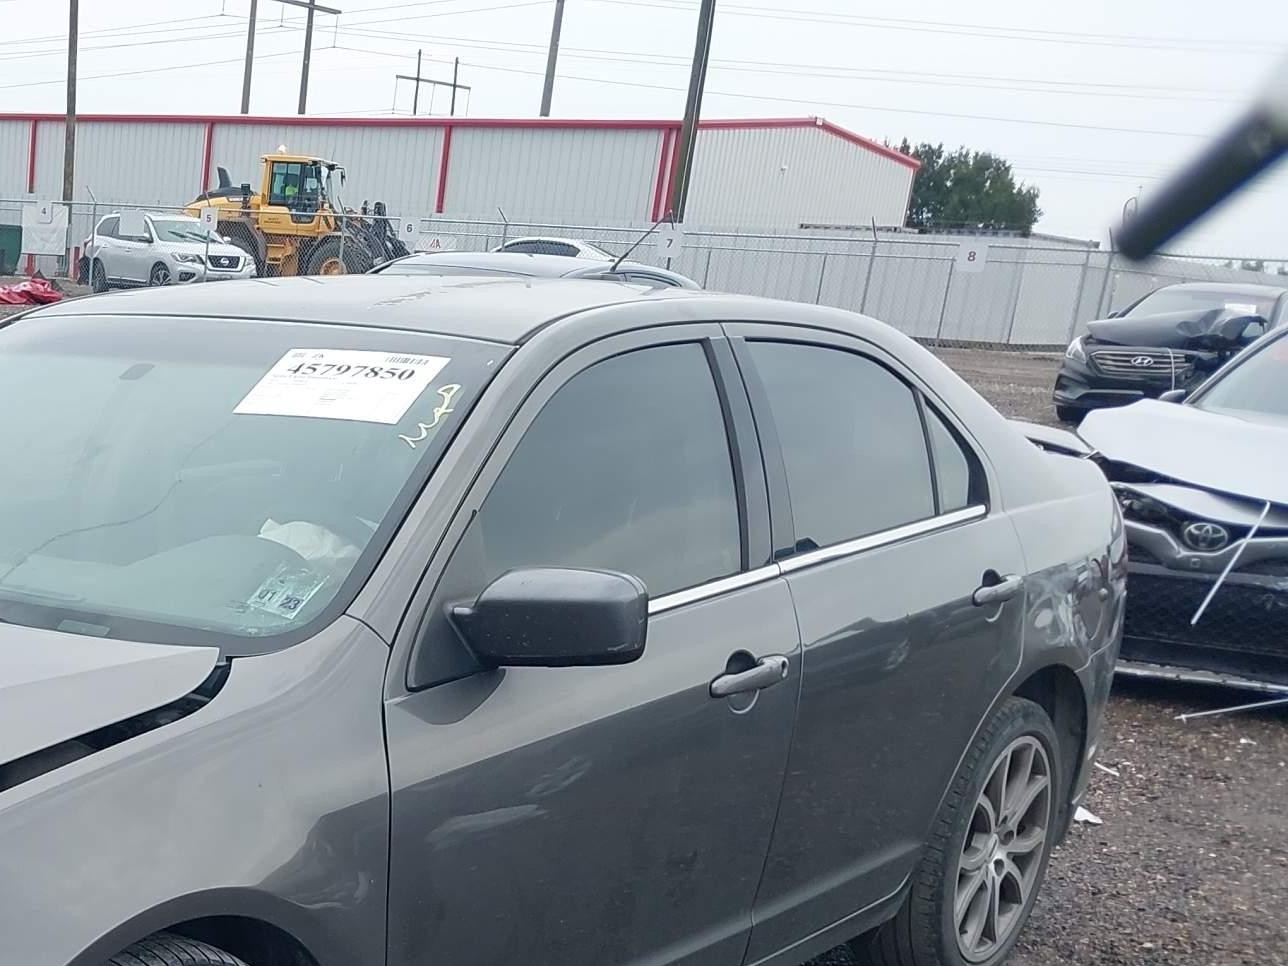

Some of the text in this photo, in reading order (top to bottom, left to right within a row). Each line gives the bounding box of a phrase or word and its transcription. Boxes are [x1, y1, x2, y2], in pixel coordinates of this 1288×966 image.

[206, 214, 212, 223] 5
[406, 224, 413, 233] 6
[666, 238, 674, 248] 7
[967, 250, 977, 262] 8
[287, 362, 416, 381] 45797850
